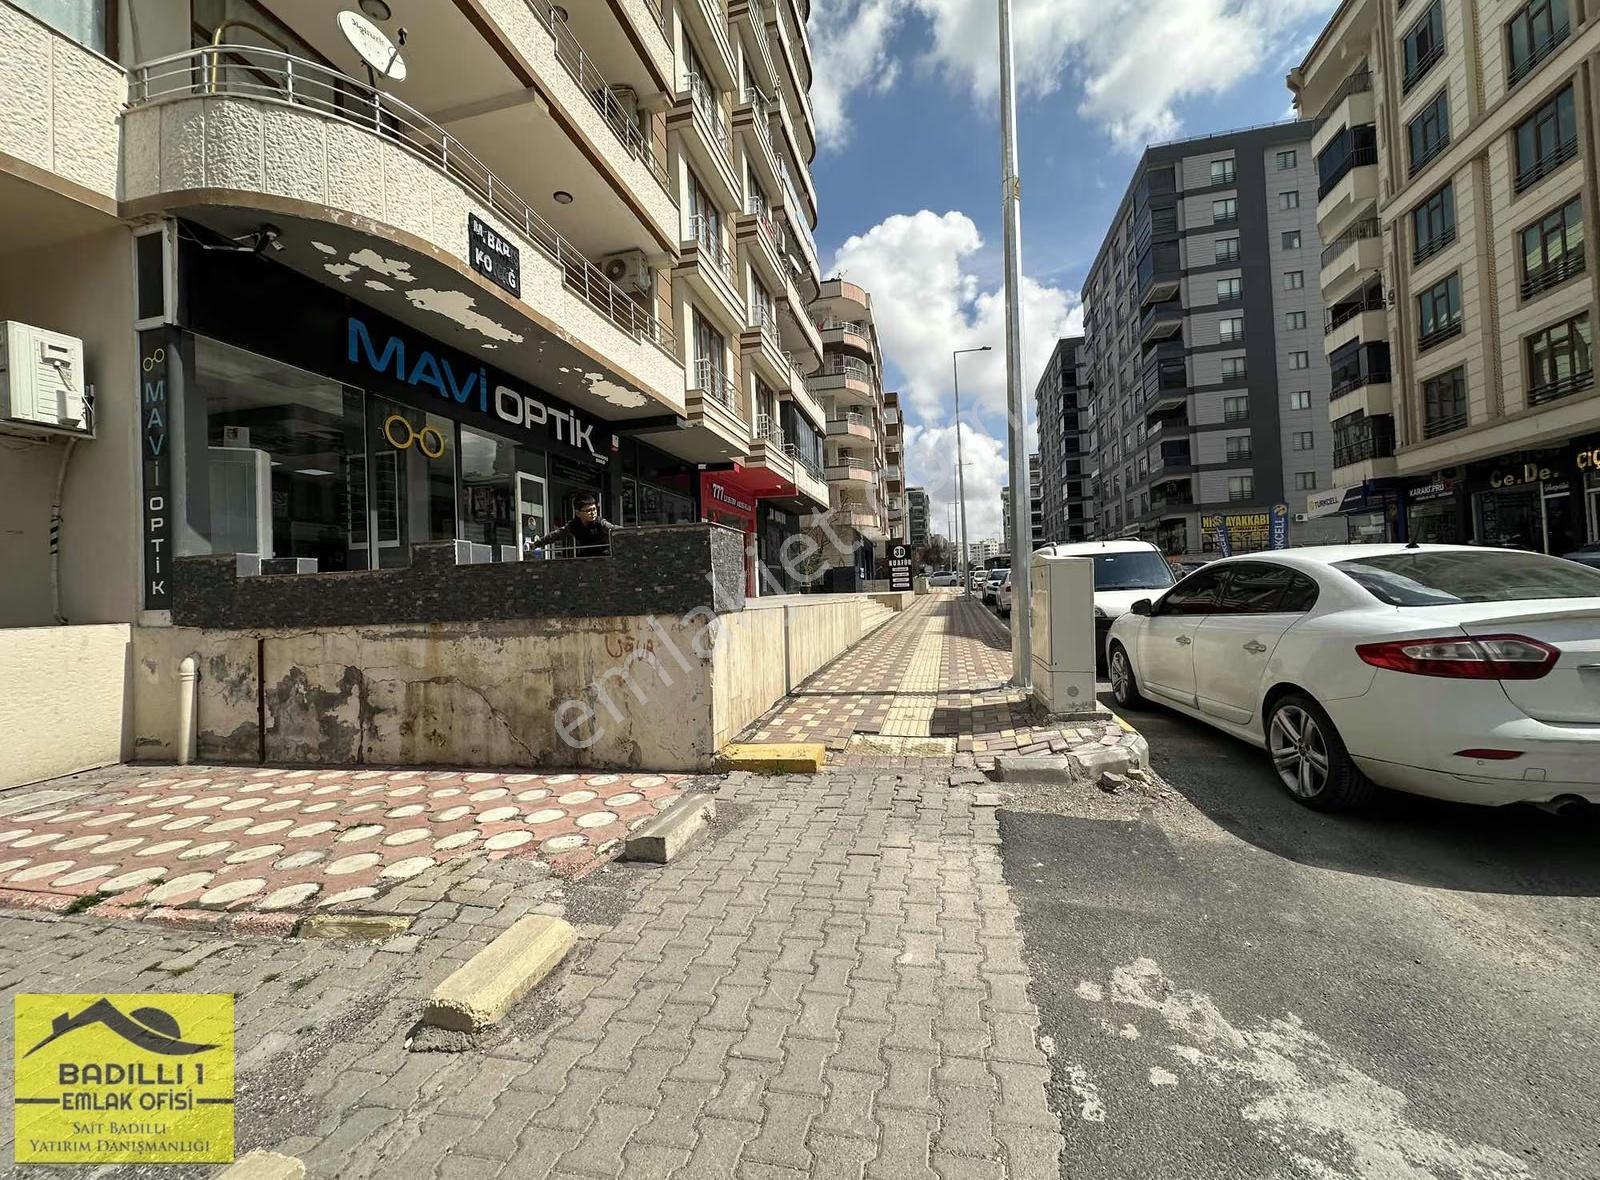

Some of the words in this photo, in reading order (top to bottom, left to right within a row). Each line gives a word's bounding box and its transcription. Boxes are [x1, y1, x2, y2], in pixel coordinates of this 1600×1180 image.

[348, 317, 487, 412] MAVİ
[495, 385, 594, 452] OPTİK
[149, 497, 165, 595] OPTİK
[1226, 514, 1269, 527] AYAKKABI
